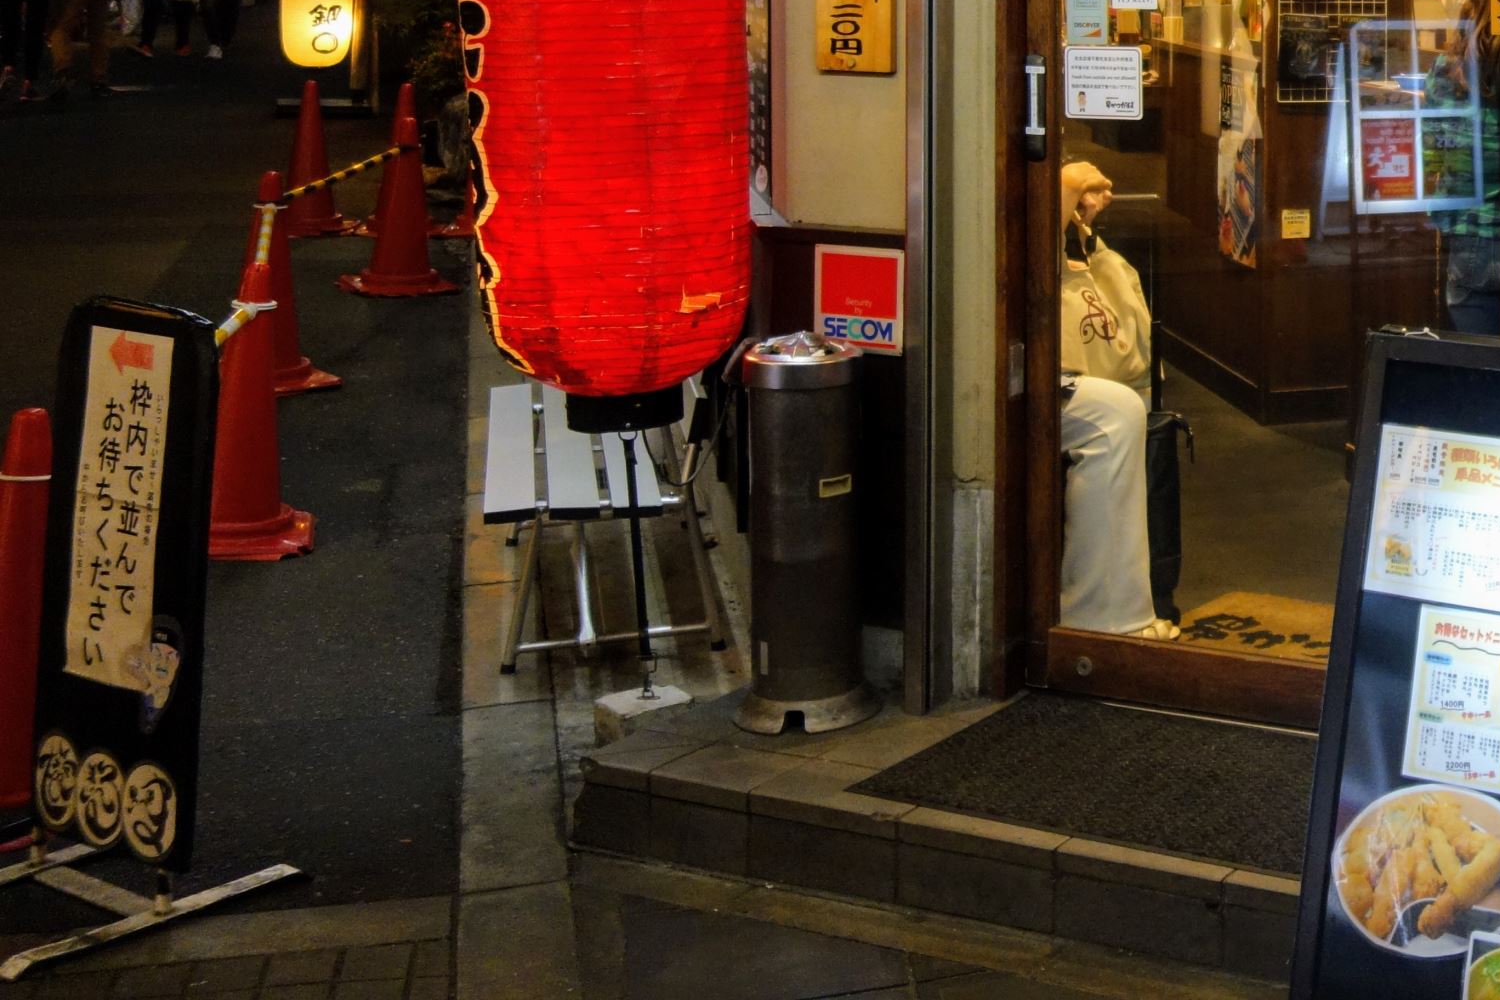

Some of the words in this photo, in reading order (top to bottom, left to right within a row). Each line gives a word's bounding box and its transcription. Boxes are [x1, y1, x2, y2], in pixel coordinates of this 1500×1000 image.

[823, 316, 893, 342] SECOM
[83, 398, 124, 666] お待ちください
[115, 379, 152, 615] 枠内で並んで
